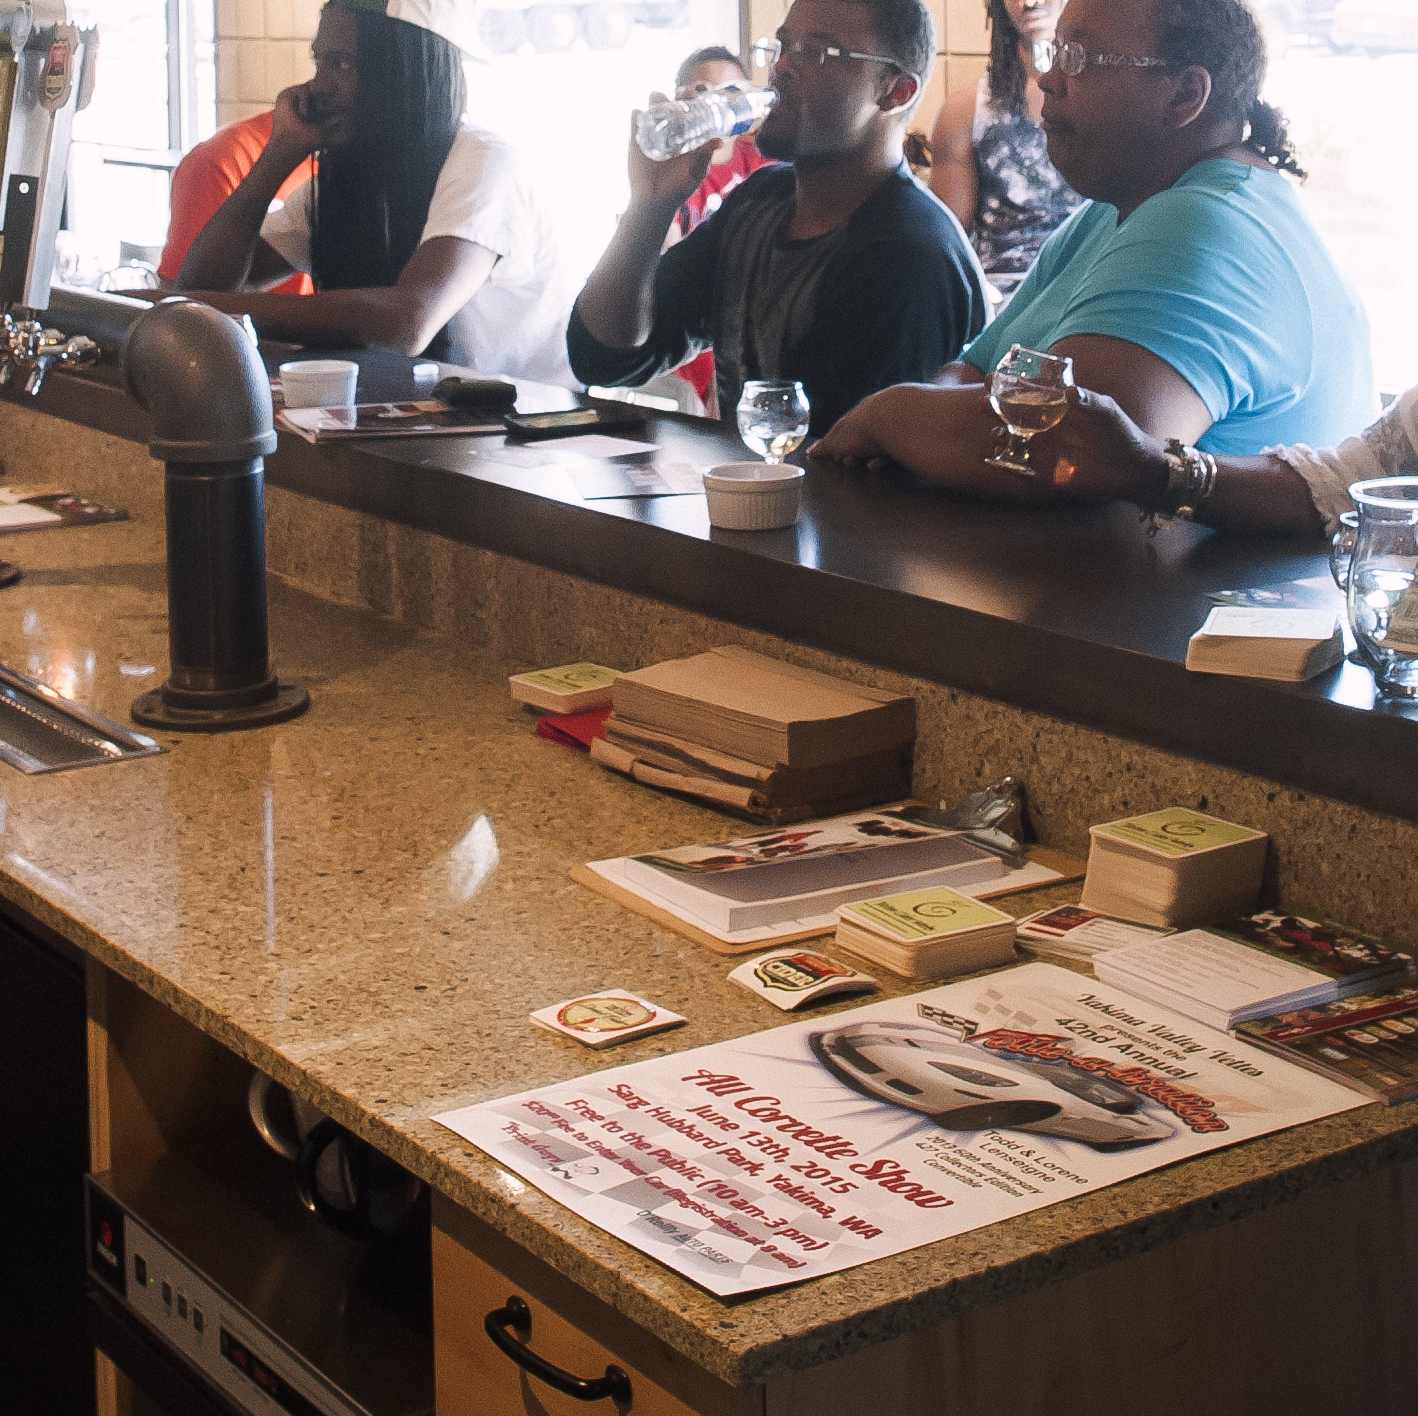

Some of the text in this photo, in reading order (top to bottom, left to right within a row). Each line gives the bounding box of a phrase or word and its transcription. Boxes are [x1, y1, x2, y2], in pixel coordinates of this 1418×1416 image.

[765, 961, 815, 986] CIDER
[1055, 1018, 1198, 1080] 42nd Annual
[1077, 993, 1146, 1026] Yakima
[1147, 1024, 1207, 1054] Valley
[1098, 1024, 1187, 1061] presents the
[607, 1083, 883, 1240] Sarg Hubbard Park, Yakima, WA
[681, 1069, 953, 1209] All Corvette Show
[686, 1104, 859, 1194] June 13th, 2015
[979, 1142, 1056, 1182] Lenseigne
[984, 1131, 1089, 1184] Todd & Lorene
[551, 1118, 576, 1133] Fee
[572, 1132, 590, 1142] to
[585, 1140, 623, 1161] Enter
[617, 1158, 649, 1177] Your
[642, 1175, 672, 1190] Car
[742, 1236, 767, 1246] at
[759, 1244, 779, 1254] 8
[769, 1252, 808, 1269] am)
[565, 1099, 606, 1122] Free
[600, 1120, 624, 1133] to
[619, 1132, 653, 1151] the
[647, 1148, 705, 1182] Public
[696, 1179, 739, 1200] (10
[773, 1227, 830, 1251] pm)
[923, 1158, 983, 1188] Convertible
[978, 1162, 1043, 1194] Anniversary
[983, 1176, 1024, 1198] Edition
